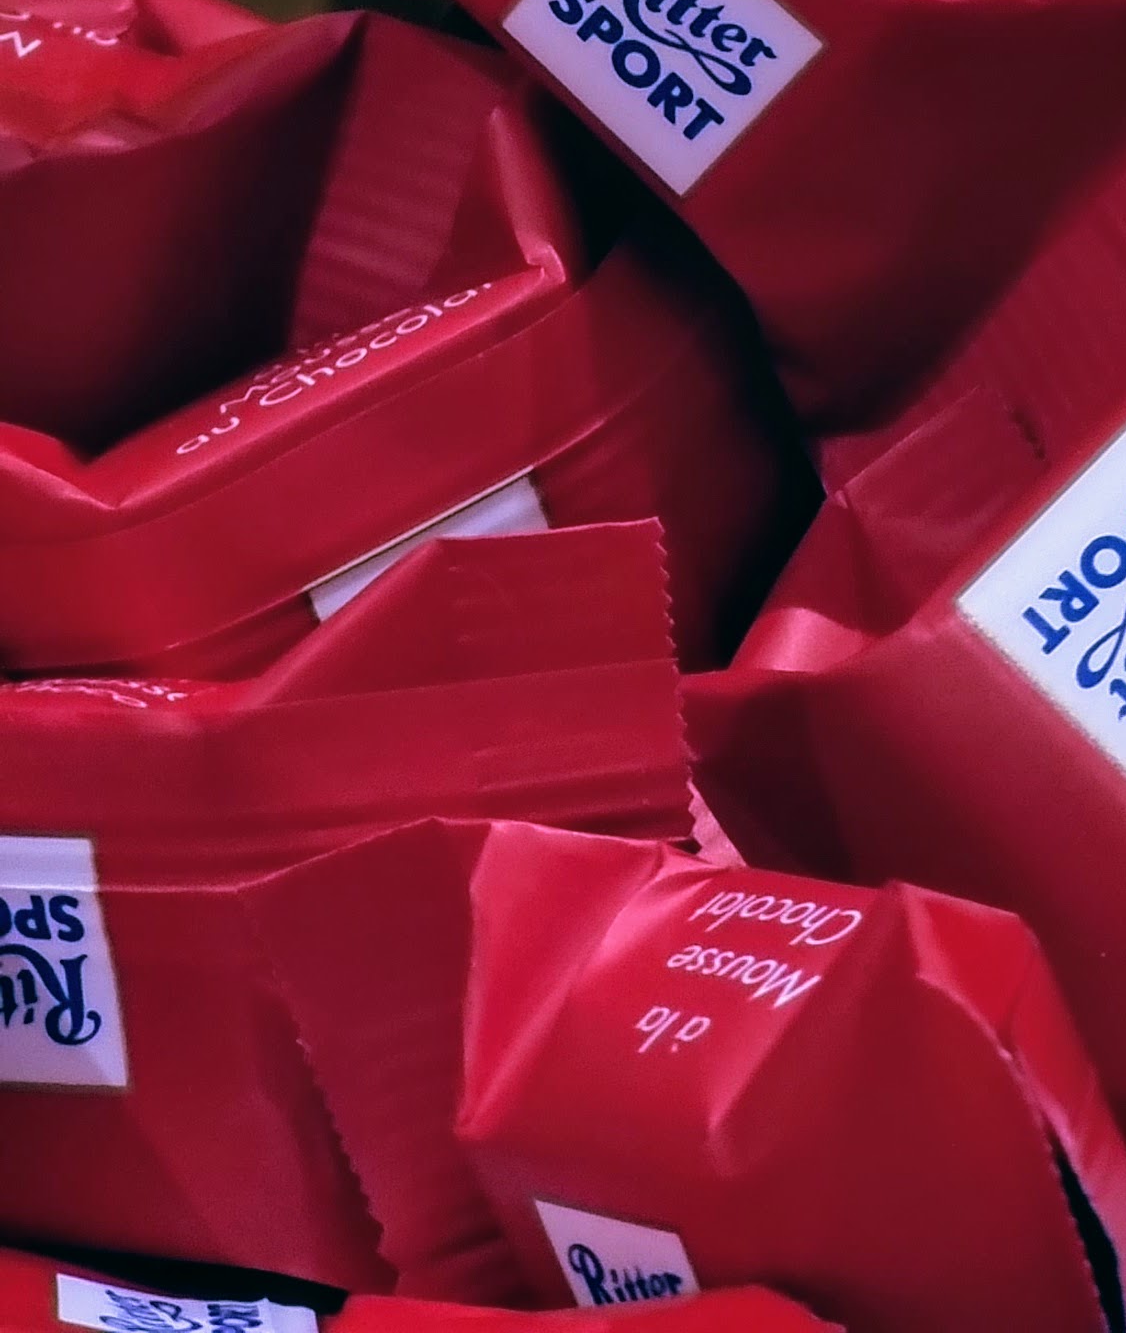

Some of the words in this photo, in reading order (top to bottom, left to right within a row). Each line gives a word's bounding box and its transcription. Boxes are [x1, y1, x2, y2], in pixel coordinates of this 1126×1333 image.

[176, 417, 240, 454] au
[688, 890, 863, 946] Chocolat
[667, 944, 821, 1009] Mousse
[635, 1005, 673, 1053] la
